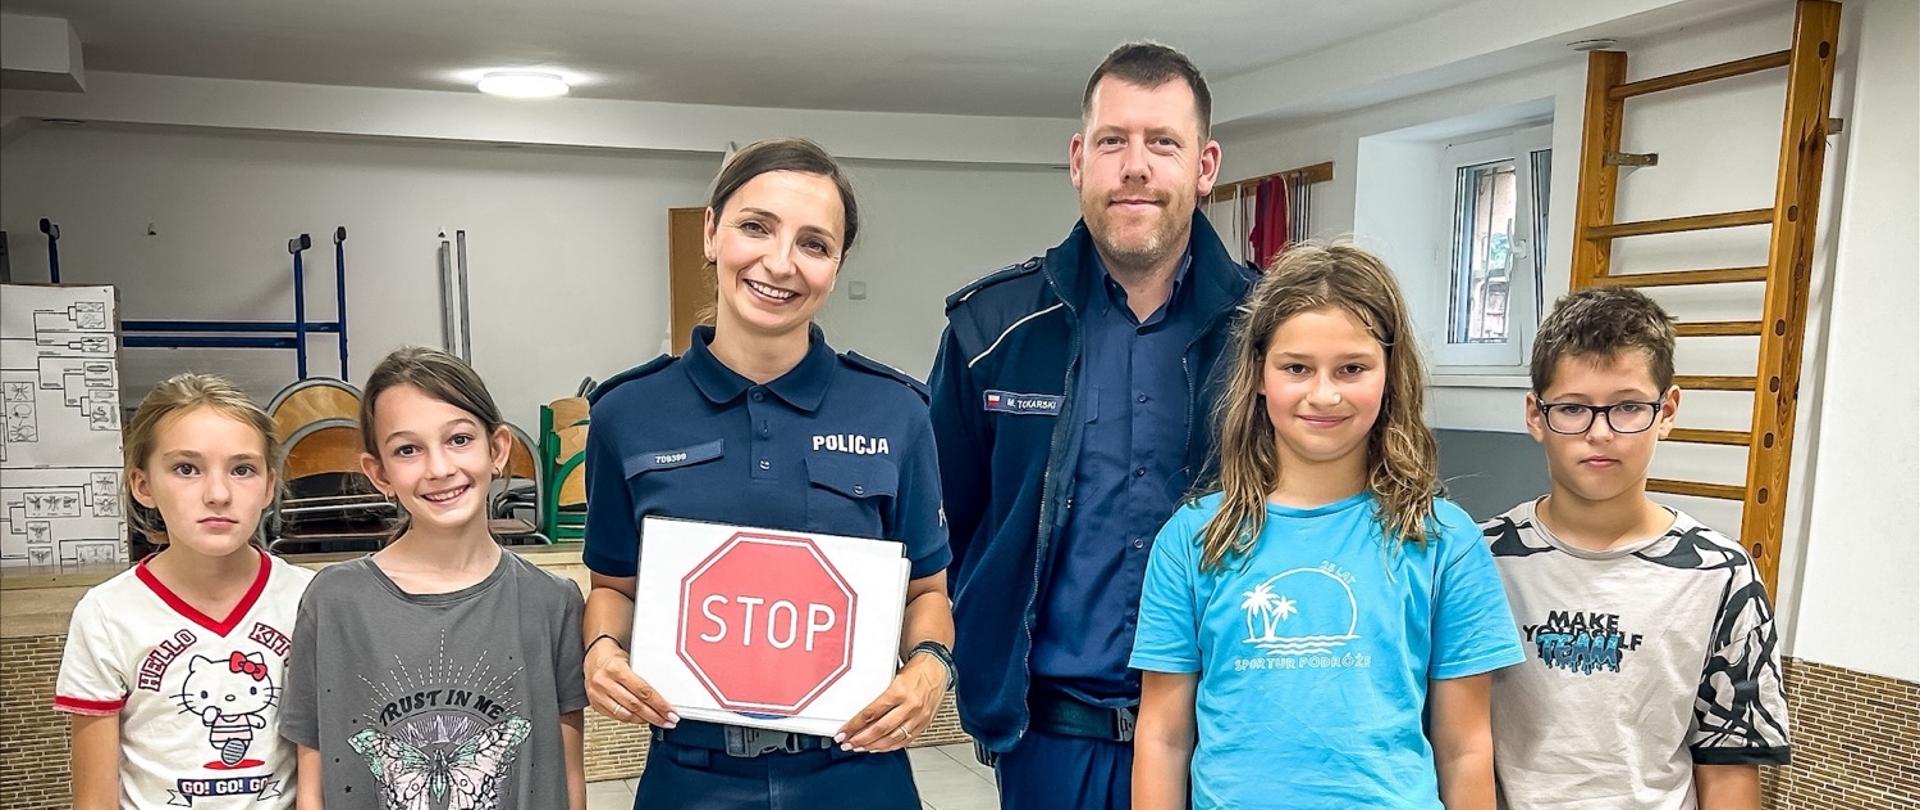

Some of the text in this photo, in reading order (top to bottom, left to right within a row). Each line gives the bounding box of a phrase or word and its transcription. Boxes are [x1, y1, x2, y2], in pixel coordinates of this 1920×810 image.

[812, 434, 889, 455] POLICJA
[700, 594, 836, 652] STOP
[1547, 610, 1620, 633] MAKE
[138, 629, 197, 692] HELLO
[1536, 632, 1622, 676] TEAM
[379, 689, 505, 727] TRUST IN ME
[181, 781, 210, 795] GO!
[215, 780, 244, 794] GO!
